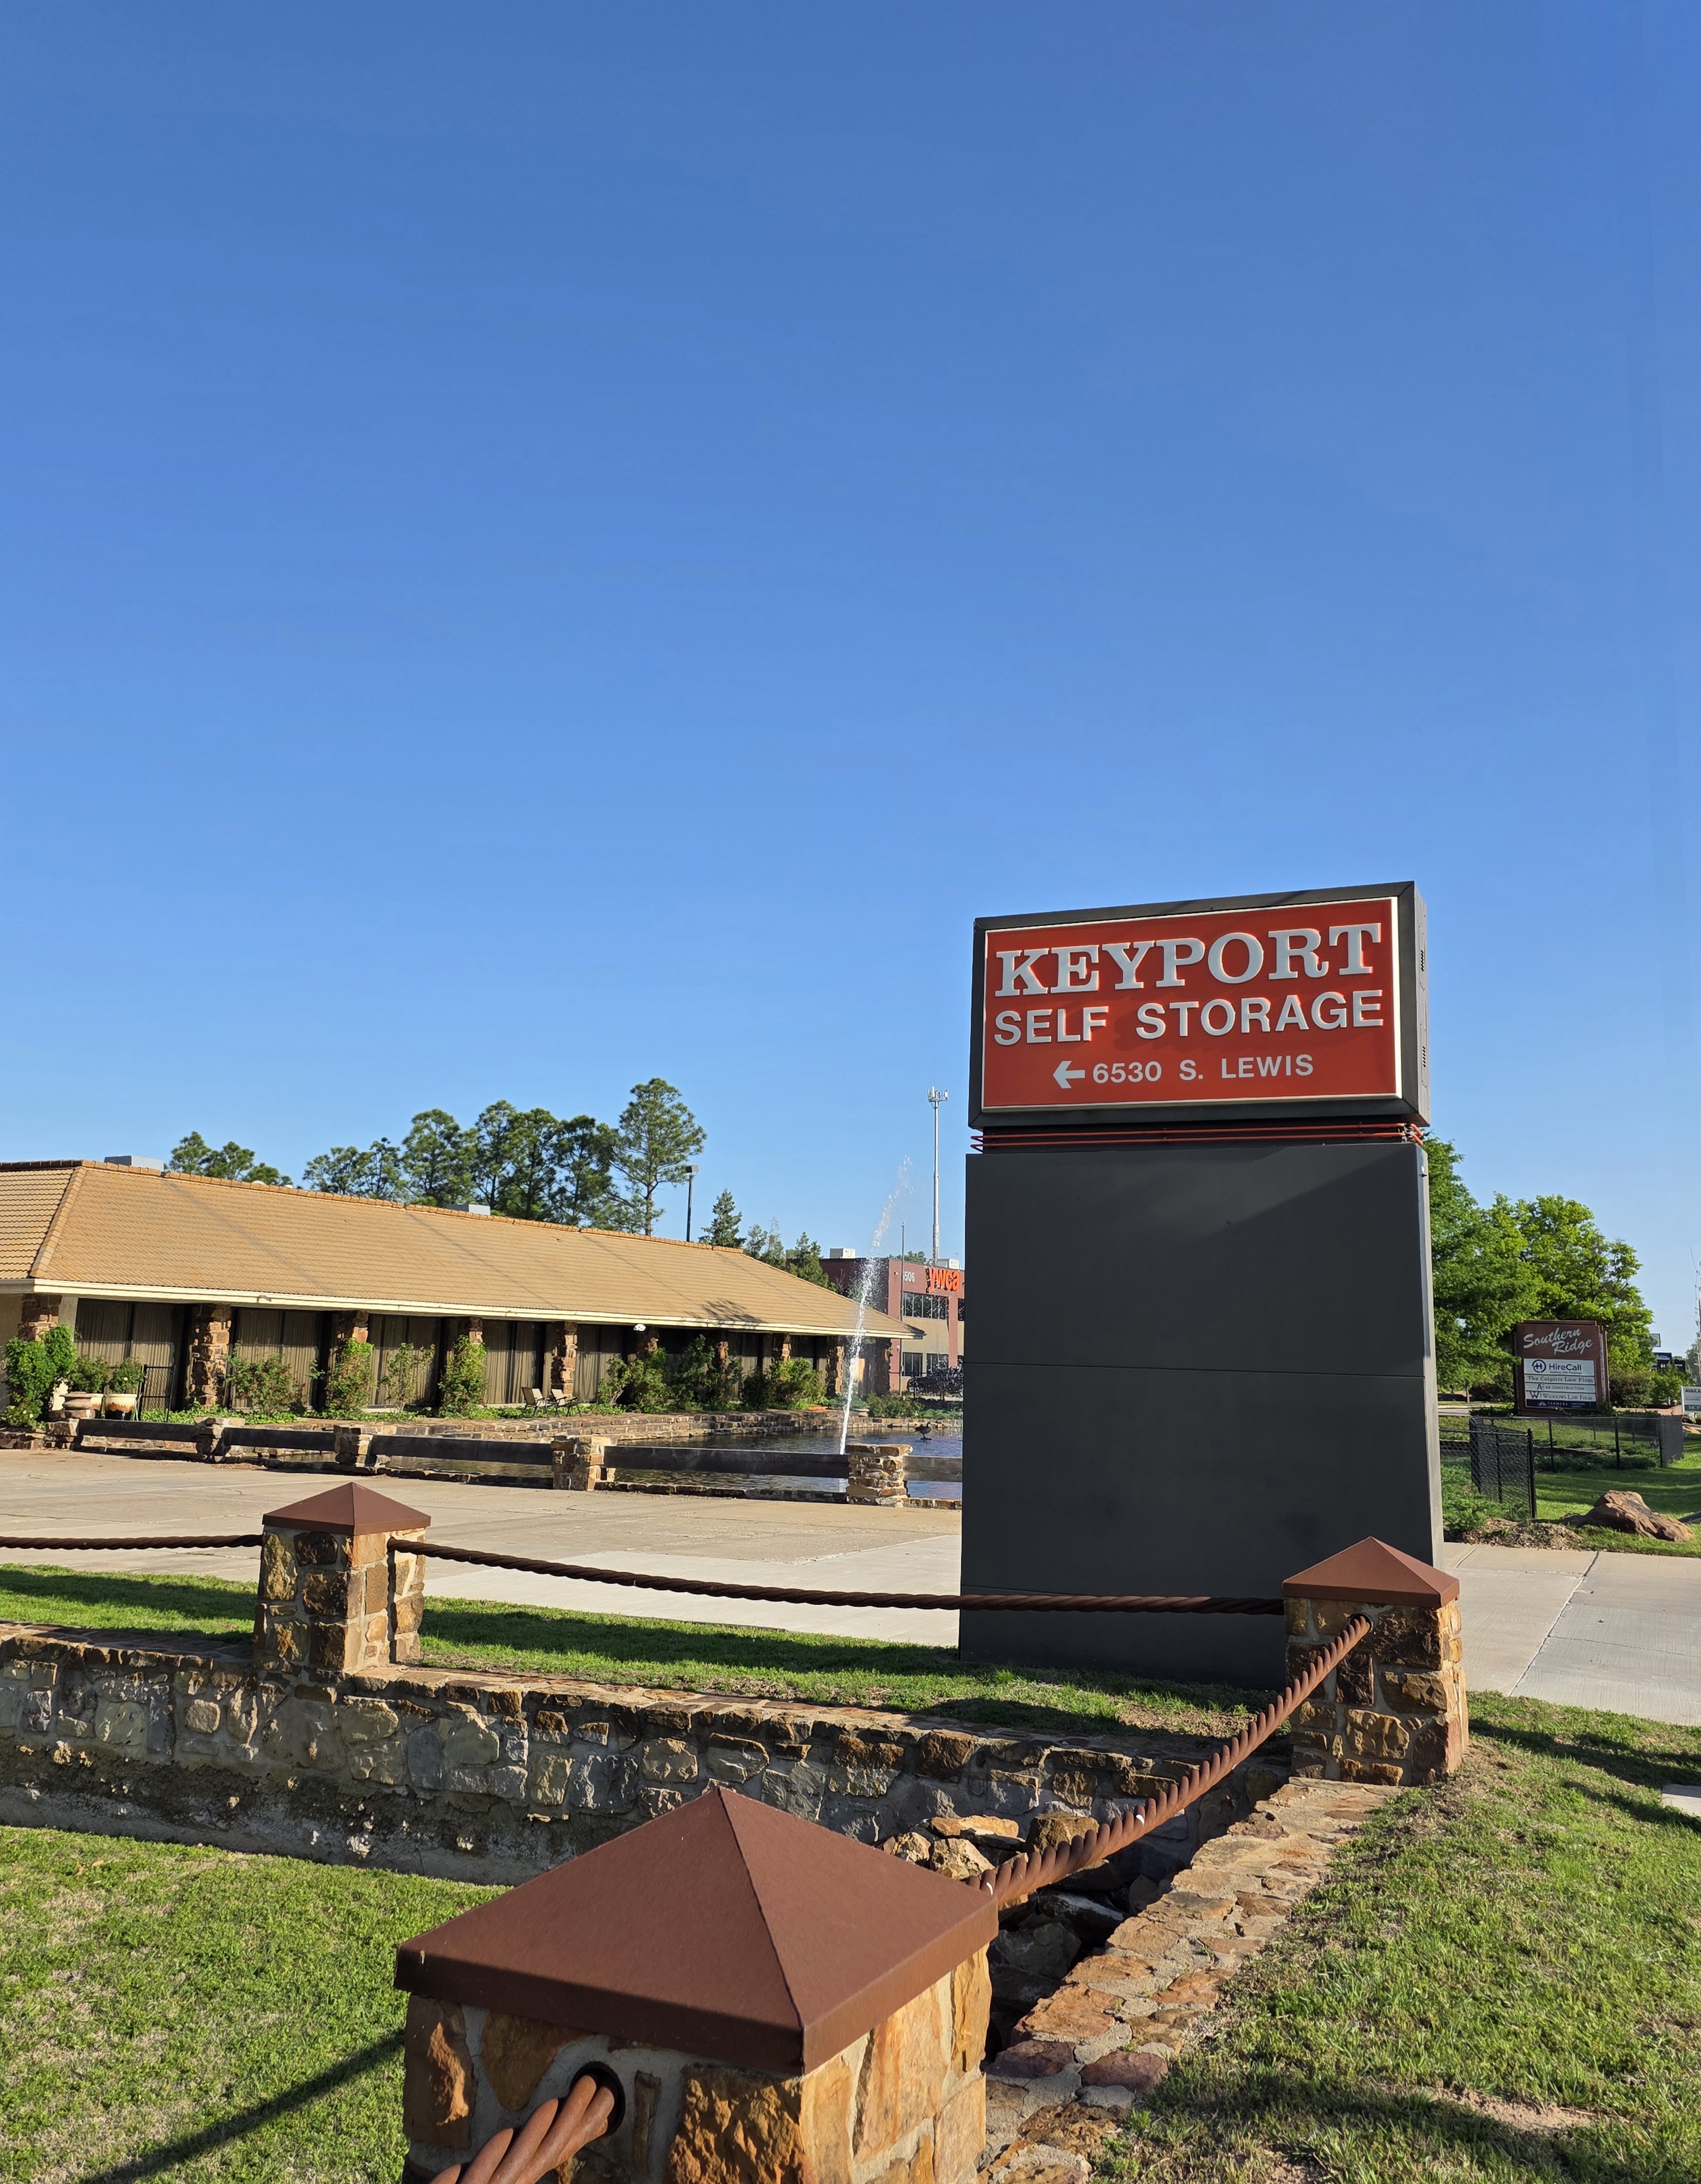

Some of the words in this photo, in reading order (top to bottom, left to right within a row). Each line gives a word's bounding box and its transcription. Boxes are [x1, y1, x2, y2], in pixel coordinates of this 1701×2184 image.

[995, 922, 1382, 998] KEYPORT
[994, 1005, 1110, 1047] SELF
[1136, 989, 1384, 1040] STORAGE
[1093, 1060, 1163, 1084] 6530
[1180, 1059, 1204, 1080] S.
[1222, 1053, 1314, 1078] LEWIS
[928, 1267, 961, 1292] ywca
[1523, 1327, 1582, 1348] Southern
[1551, 1338, 1593, 1355] Ridge
[1548, 1363, 1582, 1371] HireCall
